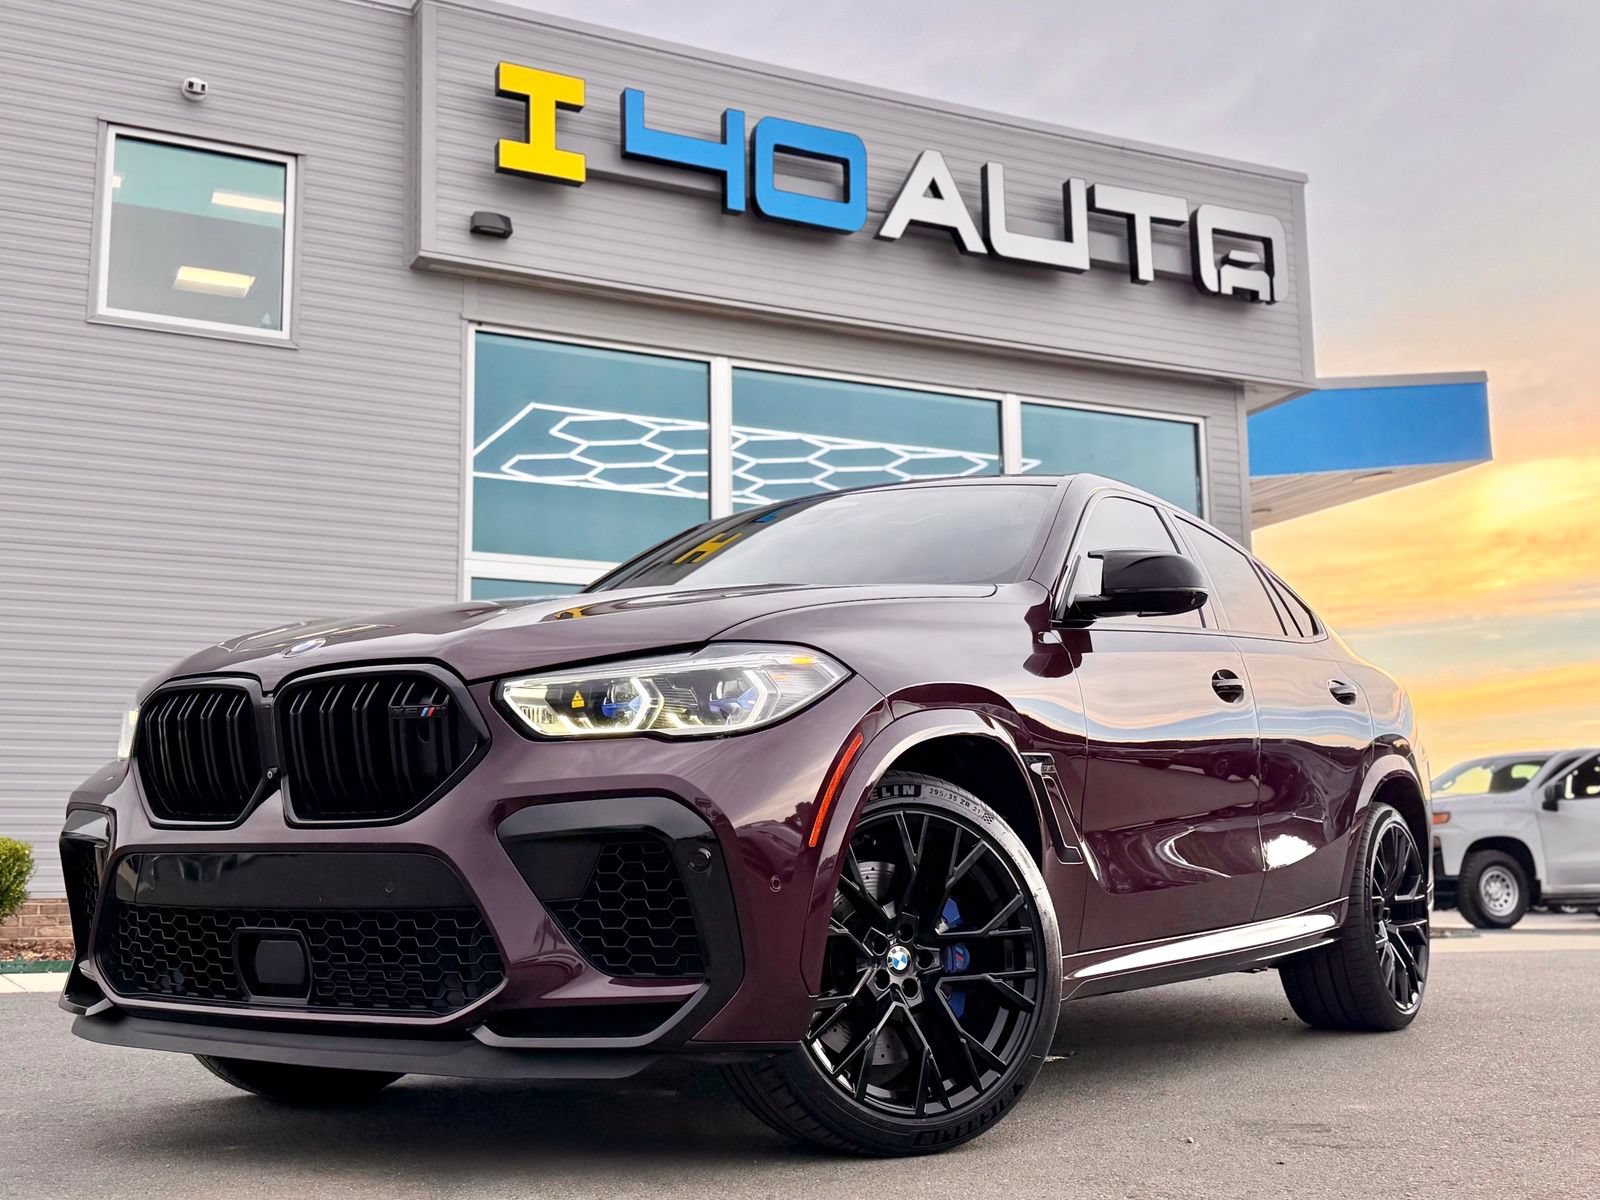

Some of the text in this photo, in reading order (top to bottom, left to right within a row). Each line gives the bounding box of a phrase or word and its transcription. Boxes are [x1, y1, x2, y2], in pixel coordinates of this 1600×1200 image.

[495, 61, 587, 187] I
[621, 87, 868, 233] 40
[928, 787, 958, 802] 295/35
[959, 798, 971, 808] ZR
